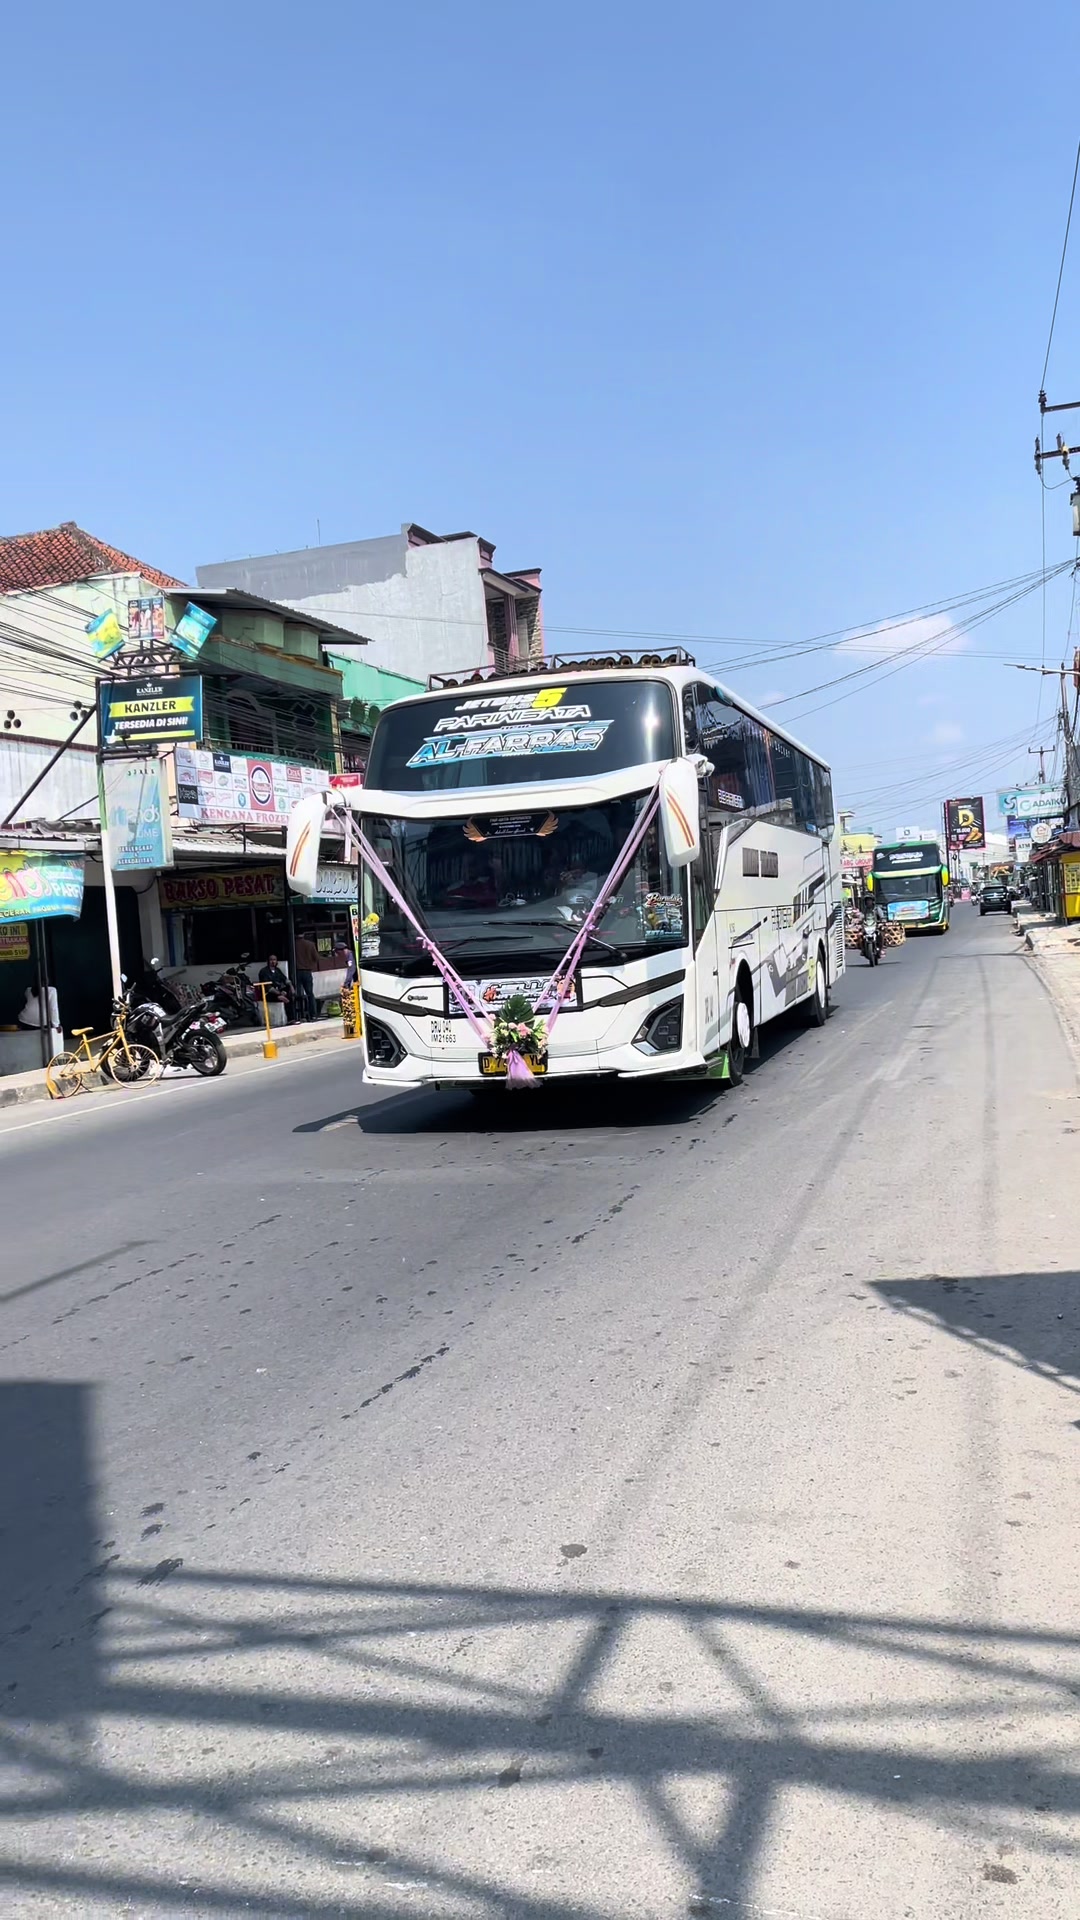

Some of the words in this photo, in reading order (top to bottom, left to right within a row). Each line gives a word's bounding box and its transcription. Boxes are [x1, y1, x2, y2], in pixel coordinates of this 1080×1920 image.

[136, 686, 163, 694] KANZLER
[124, 700, 176, 714] KANZLER
[114, 719, 155, 730] TERSEDIA
[156, 718, 166, 727] DI
[167, 716, 188, 726] SINI!
[433, 704, 592, 733] PARIWISATA
[201, 808, 254, 821] KENCANA
[163, 878, 219, 902] BAKSO
[222, 873, 275, 897] PESAT
[431, 1020, 441, 1033] DRU
[484, 1057, 490, 1069] D
